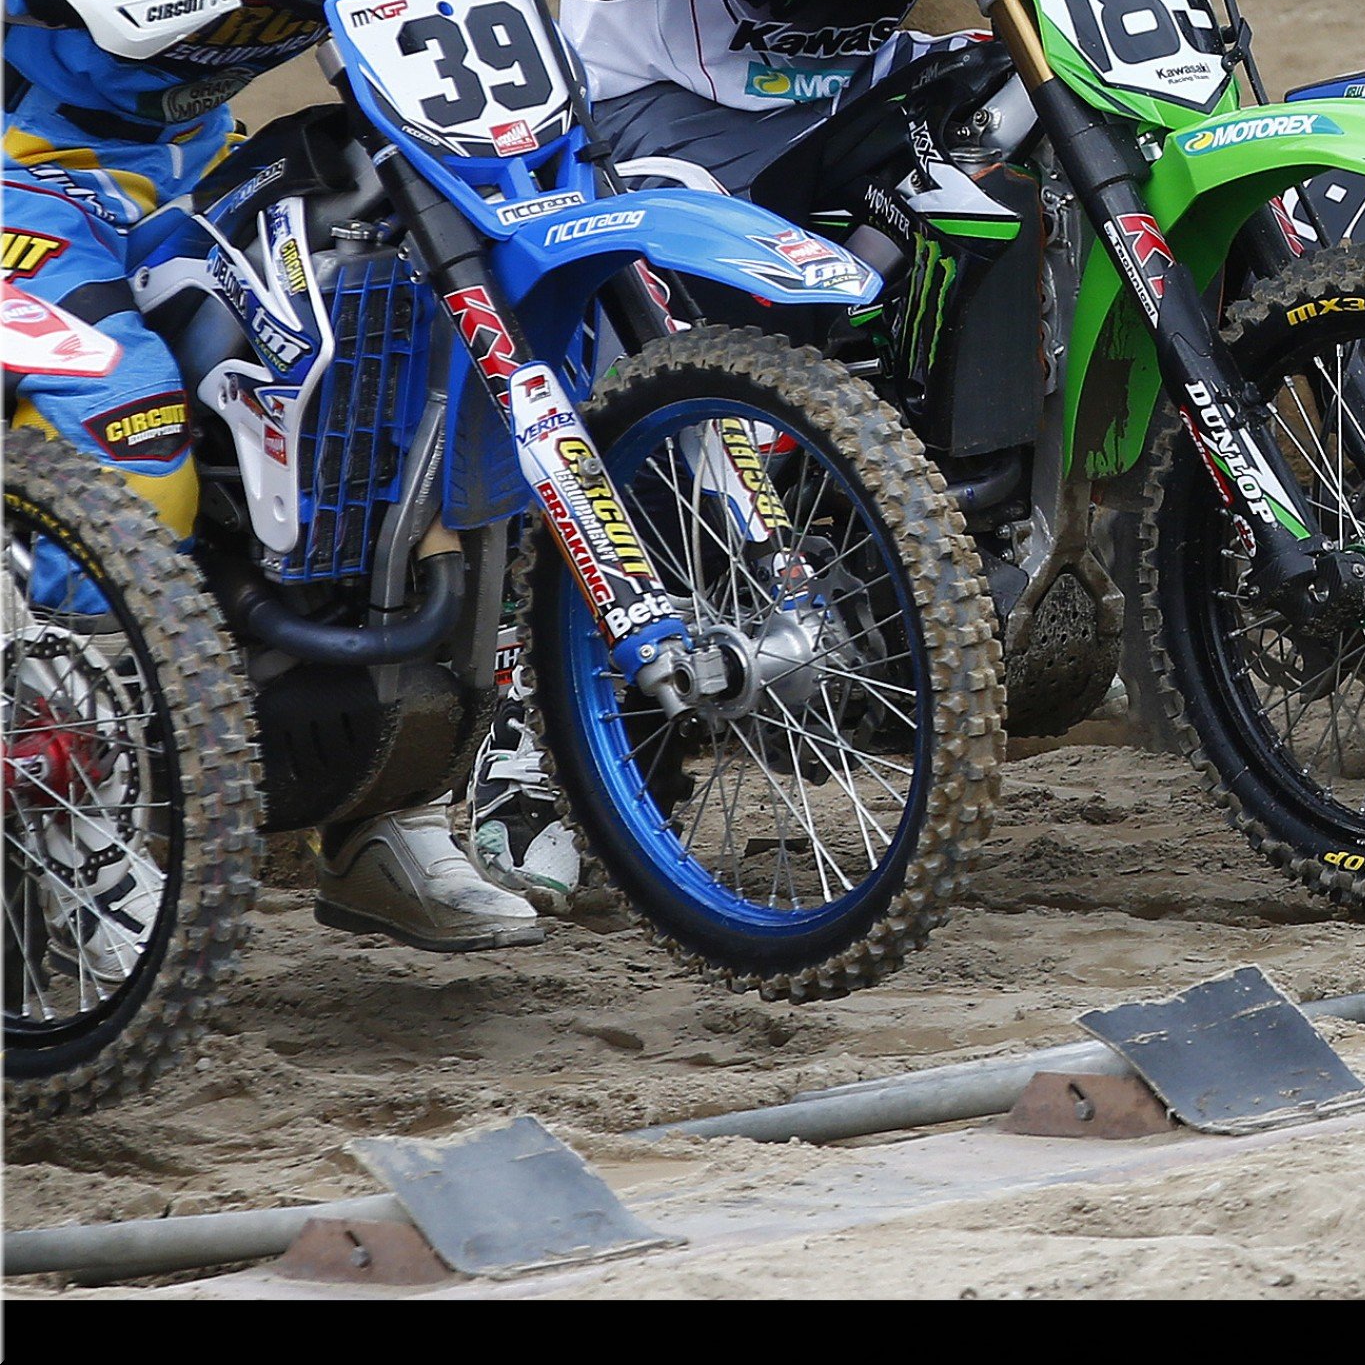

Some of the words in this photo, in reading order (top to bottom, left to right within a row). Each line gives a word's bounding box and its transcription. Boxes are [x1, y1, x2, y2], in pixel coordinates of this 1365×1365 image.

[350, 0, 409, 29] MXGP
[396, 0, 554, 129] 39
[1155, 61, 1212, 81] Kawasaki
[1211, 113, 1319, 149] MOTOREX
[516, 410, 577, 445] VERTEX
[1184, 379, 1277, 525] DUNLOP
[536, 481, 612, 606] BRAKING
[605, 591, 676, 639] Beta
